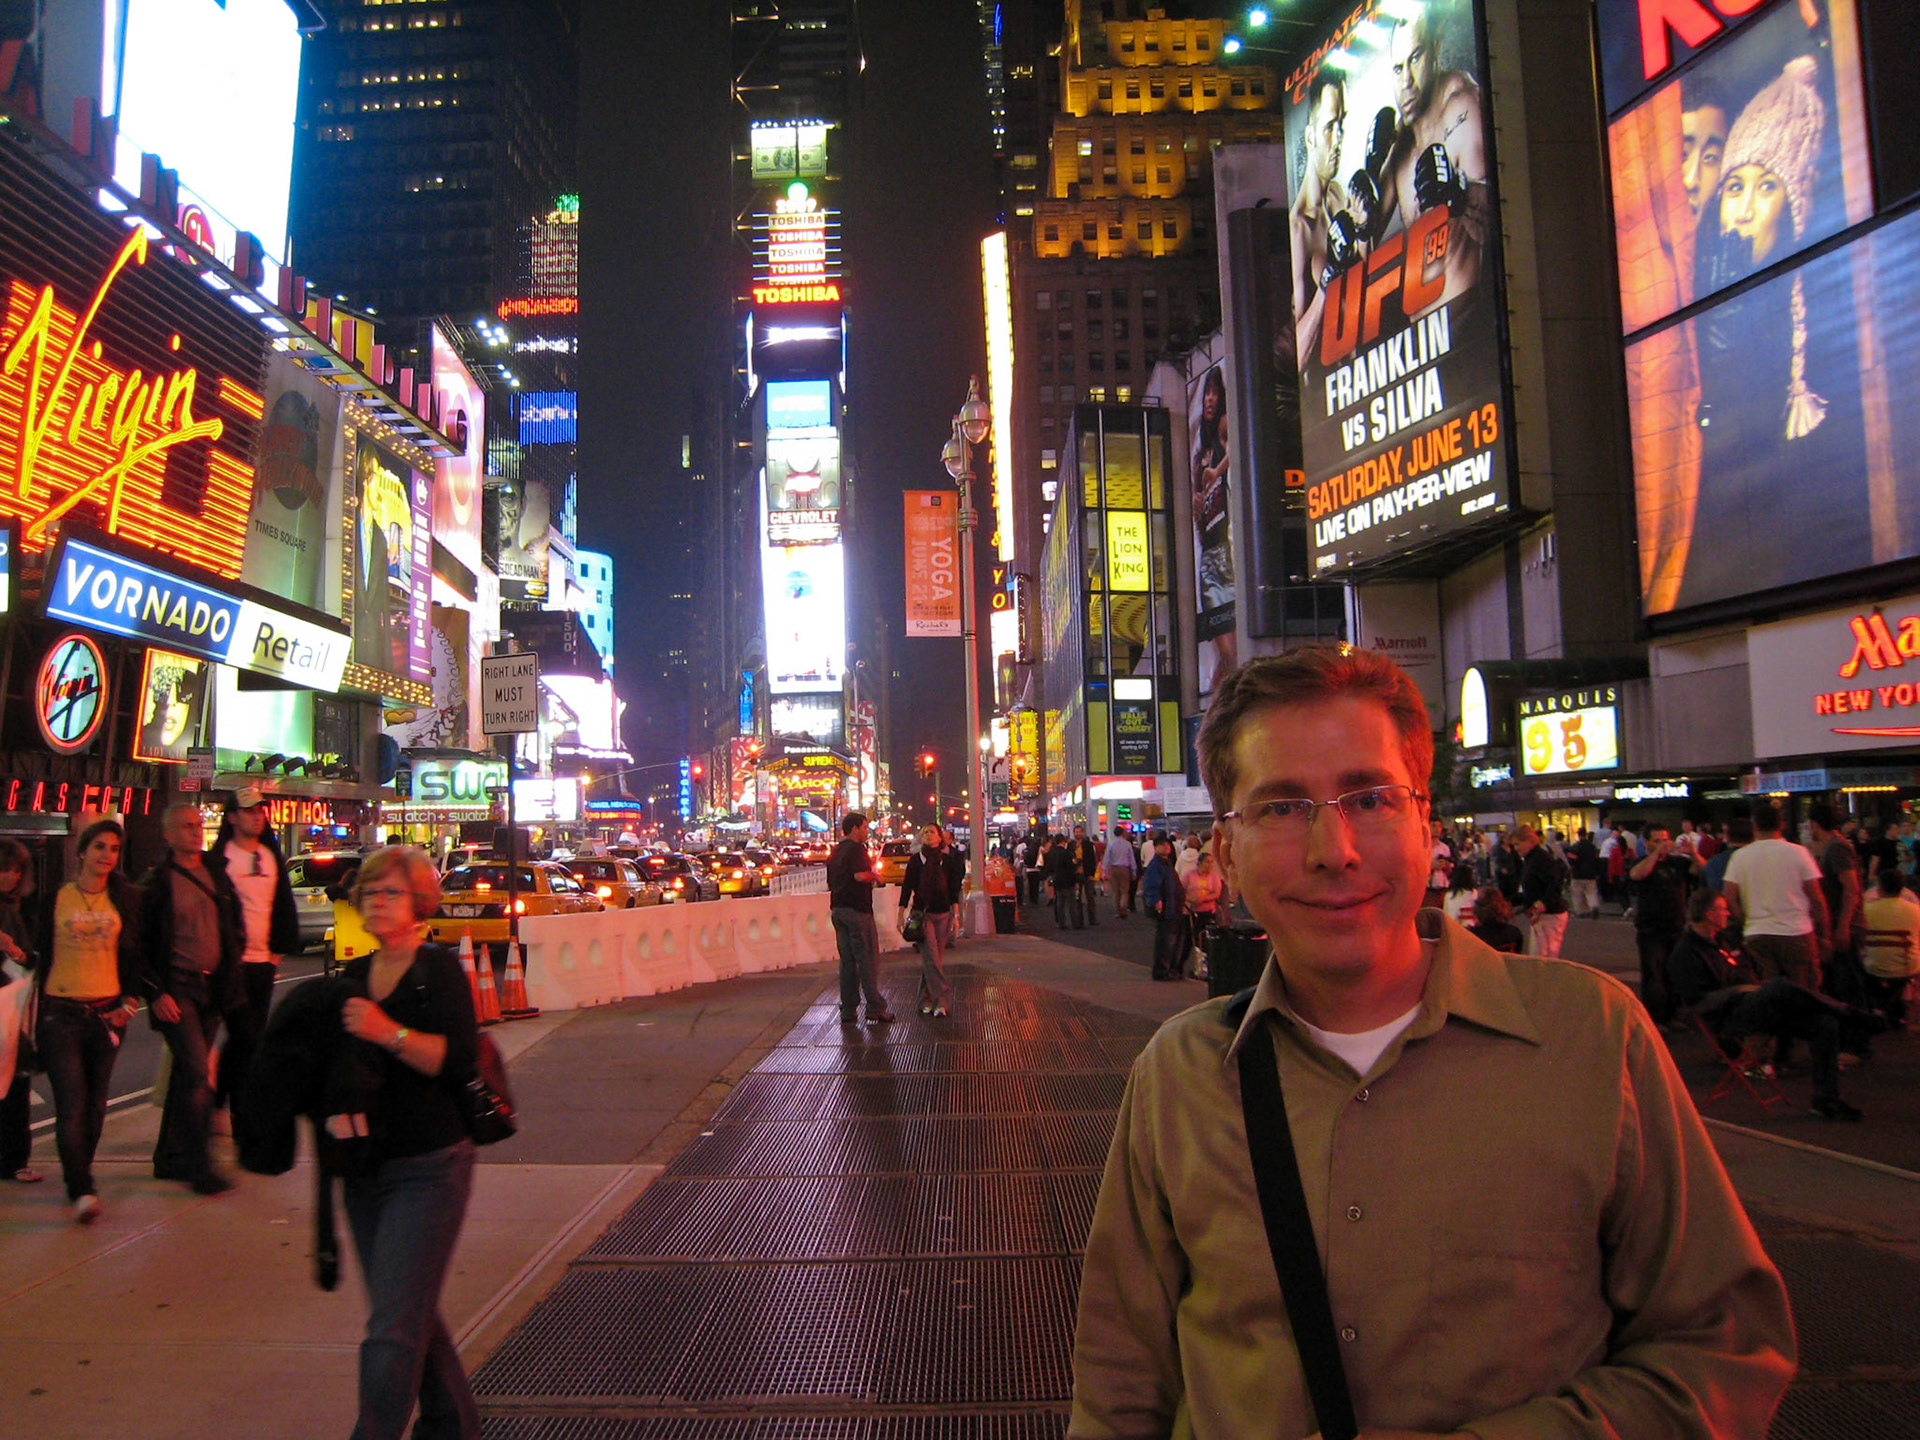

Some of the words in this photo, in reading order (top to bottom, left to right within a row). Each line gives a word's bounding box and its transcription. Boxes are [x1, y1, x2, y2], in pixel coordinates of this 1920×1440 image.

[1285, 3, 1363, 91] ULTIMATE
[1432, 146, 1448, 183] UFC
[771, 215, 823, 225] TOSHIBA
[771, 231, 824, 241] TOSHIBA
[1329, 223, 1347, 255] UFC
[1426, 224, 1448, 264] 99
[771, 247, 823, 257] TOSHIBA
[771, 263, 824, 274] TOSHIBA
[753, 286, 840, 303] TOSHIBA
[1321, 203, 1450, 366] UFC
[1325, 305, 1450, 416] FRANKLIN
[5, 225, 224, 540] Virgin
[1342, 416, 1366, 451] VS
[1371, 366, 1443, 442] SILVA
[1308, 445, 1404, 519] SATURDAY,
[1406, 418, 1463, 477] JUNE
[1467, 402, 1499, 448] 13
[1315, 519, 1347, 548] LIVE
[1346, 505, 1371, 536] ON
[1372, 451, 1493, 526] PAY-PER-VIEW
[769, 511, 837, 524] CHEVROLET
[255, 519, 279, 541] TIMES
[280, 531, 307, 553] SQUARE
[1116, 526, 1138, 538] THE
[911, 538, 927, 581] JUNE
[1113, 541, 1142, 559] LION
[931, 537, 953, 601] YOGA
[1114, 563, 1144, 580] KING
[67, 558, 232, 643] VORNADO
[252, 622, 331, 672] Retail
[1372, 636, 1428, 651] Marriott
[485, 666, 509, 679] RIGHT
[511, 662, 534, 677] LANE
[495, 687, 523, 702] MUST
[1520, 687, 1616, 715] MARQUIS
[1814, 688, 1872, 715] NEW
[1876, 681, 1920, 708] YO
[485, 713, 508, 725] TURN
[509, 710, 535, 723] RIGHT
[784, 746, 831, 754] Panasonic
[1526, 719, 1553, 773] 9
[1560, 714, 1587, 770] 5
[783, 777, 837, 790] YAHOO!
[1665, 782, 1690, 798] hut
[387, 811, 436, 822] swatch
